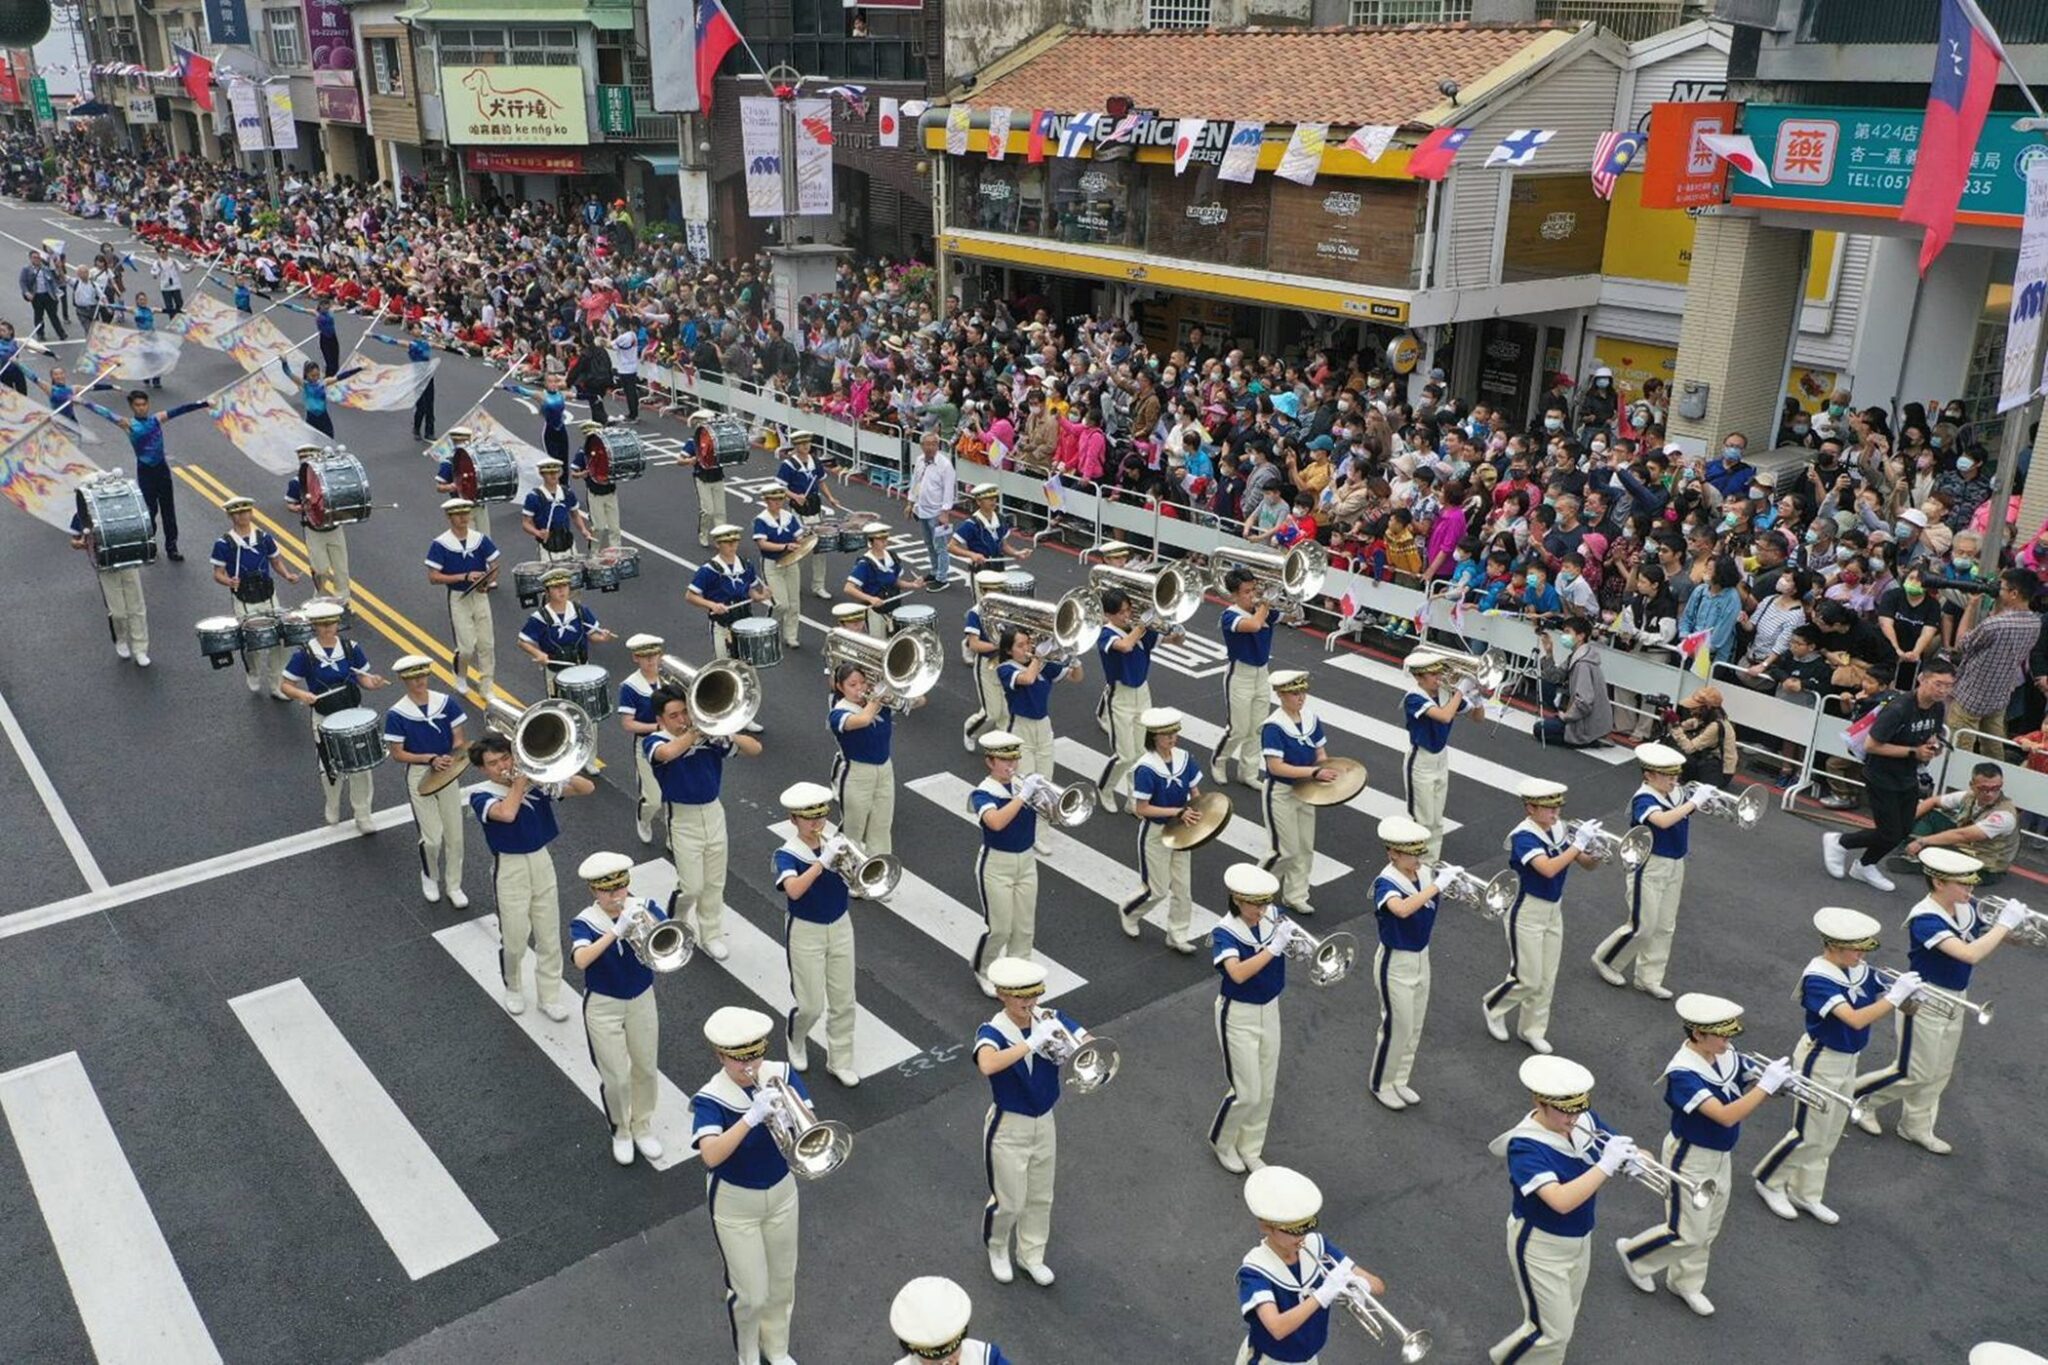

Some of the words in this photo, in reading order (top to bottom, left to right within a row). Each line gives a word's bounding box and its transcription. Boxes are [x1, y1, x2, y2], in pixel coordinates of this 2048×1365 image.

[489, 98, 548, 119] 犬行燒
[1854, 122, 1919, 142] 第424店
[1783, 129, 1827, 175] 藥
